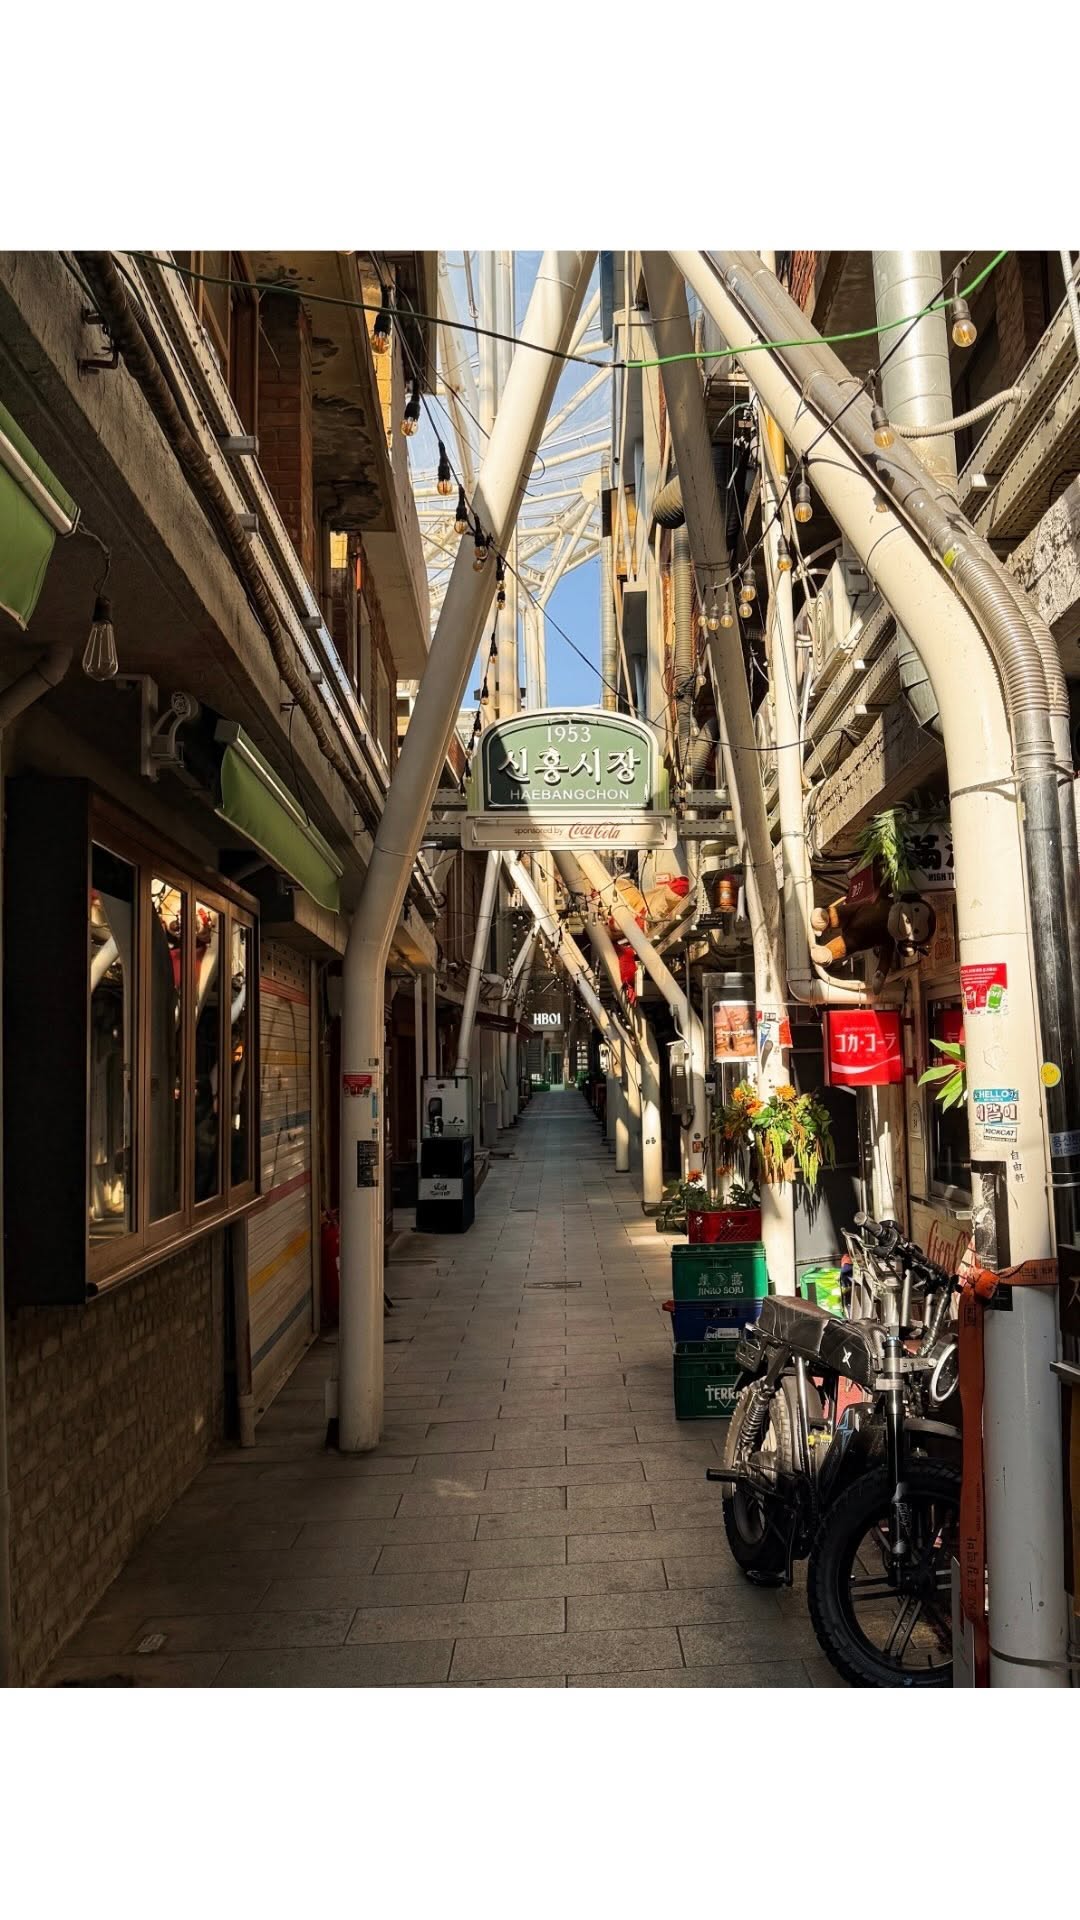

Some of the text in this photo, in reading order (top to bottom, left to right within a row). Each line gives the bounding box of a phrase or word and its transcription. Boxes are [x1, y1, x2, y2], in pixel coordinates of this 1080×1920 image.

[547, 726, 592, 743] 1953
[498, 746, 641, 786] 신흥시장
[510, 789, 630, 800] HAEBANGCHON
[514, 826, 552, 836] sponsored
[554, 826, 563, 837] by
[928, 873, 946, 882] HIGH
[698, 1286, 744, 1296] JINRO SOJU
[704, 1387, 743, 1402] TERRA
